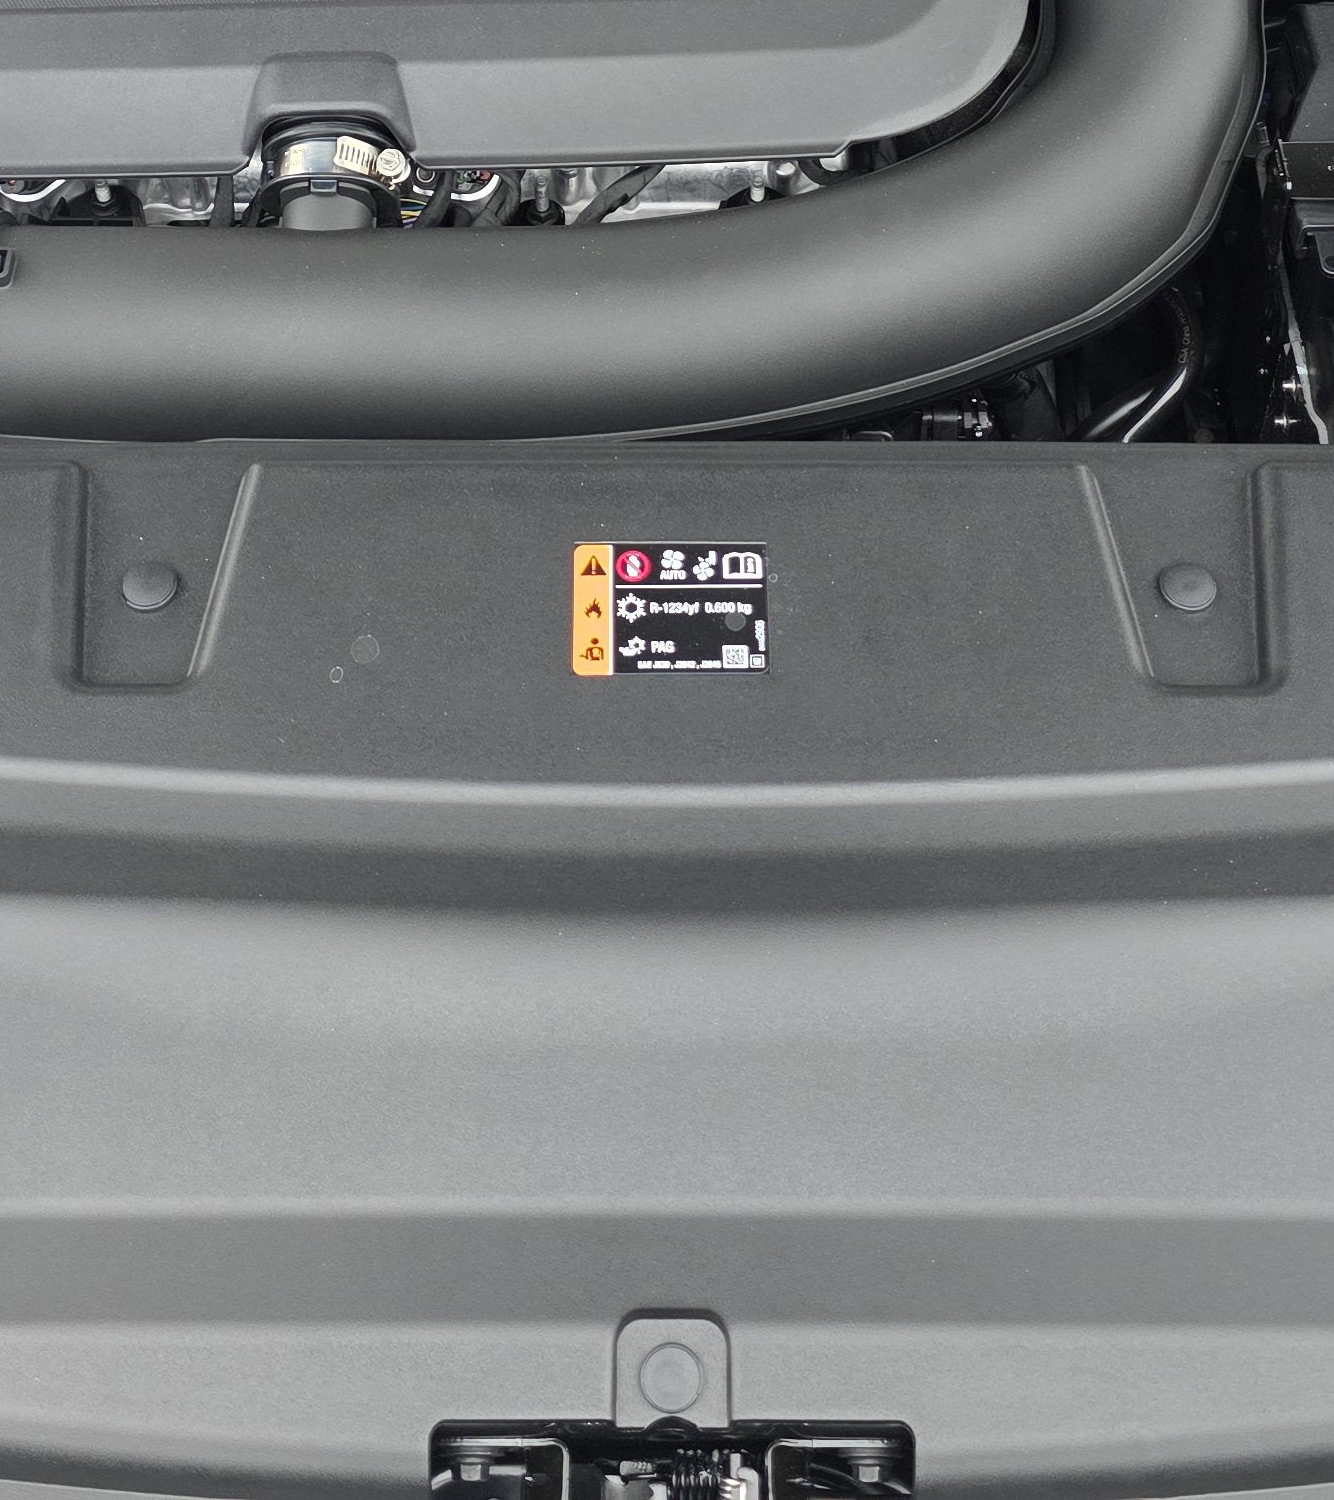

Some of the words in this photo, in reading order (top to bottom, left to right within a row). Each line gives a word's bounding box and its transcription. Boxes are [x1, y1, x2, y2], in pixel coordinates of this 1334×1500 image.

[660, 570, 686, 581] AUTO
[650, 602, 700, 616] R-1234yf
[704, 602, 736, 614] 0.600
[736, 602, 752, 616] kg
[651, 640, 676, 654] PAG
